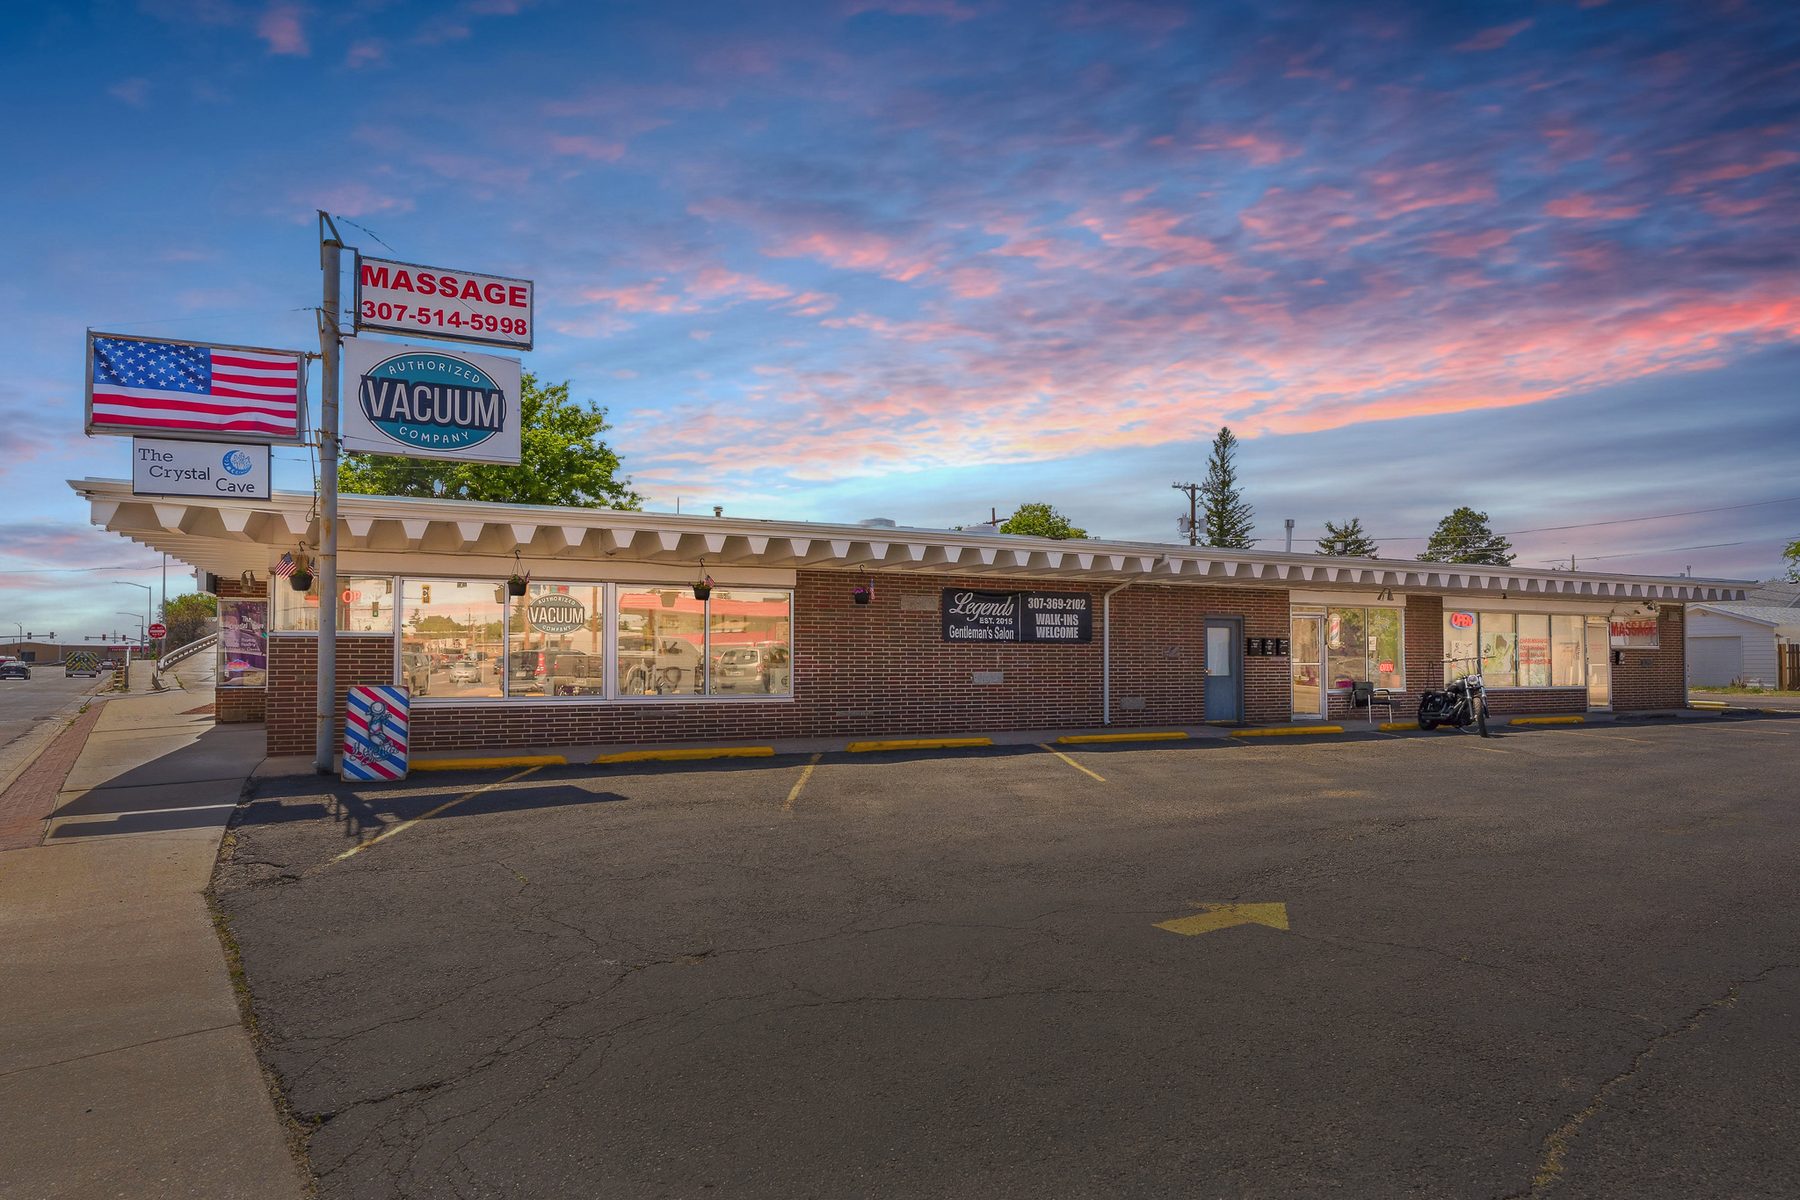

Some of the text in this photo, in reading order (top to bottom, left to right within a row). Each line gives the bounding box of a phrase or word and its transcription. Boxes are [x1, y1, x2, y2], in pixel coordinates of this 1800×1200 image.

[361, 265, 527, 308] MASSAGE
[362, 300, 527, 336] 307-514-5998
[388, 361, 480, 384] AUTHORIZED
[367, 380, 499, 428] VACUUM
[399, 426, 469, 443] COMPANY
[138, 448, 174, 462] The
[149, 465, 210, 482] Crystal
[215, 478, 255, 493] Cave
[538, 596, 576, 606] AUTHORIZED
[948, 592, 1015, 622] Legends
[1028, 597, 1086, 610] 307-369-2102
[530, 607, 584, 624] VACUUM
[979, 617, 995, 625] EST.
[1035, 613, 1079, 626] WALK-INS
[542, 624, 571, 632] COMPANY
[949, 625, 1014, 640] Gentleman's Salon
[1036, 626, 1079, 639] WELCOME
